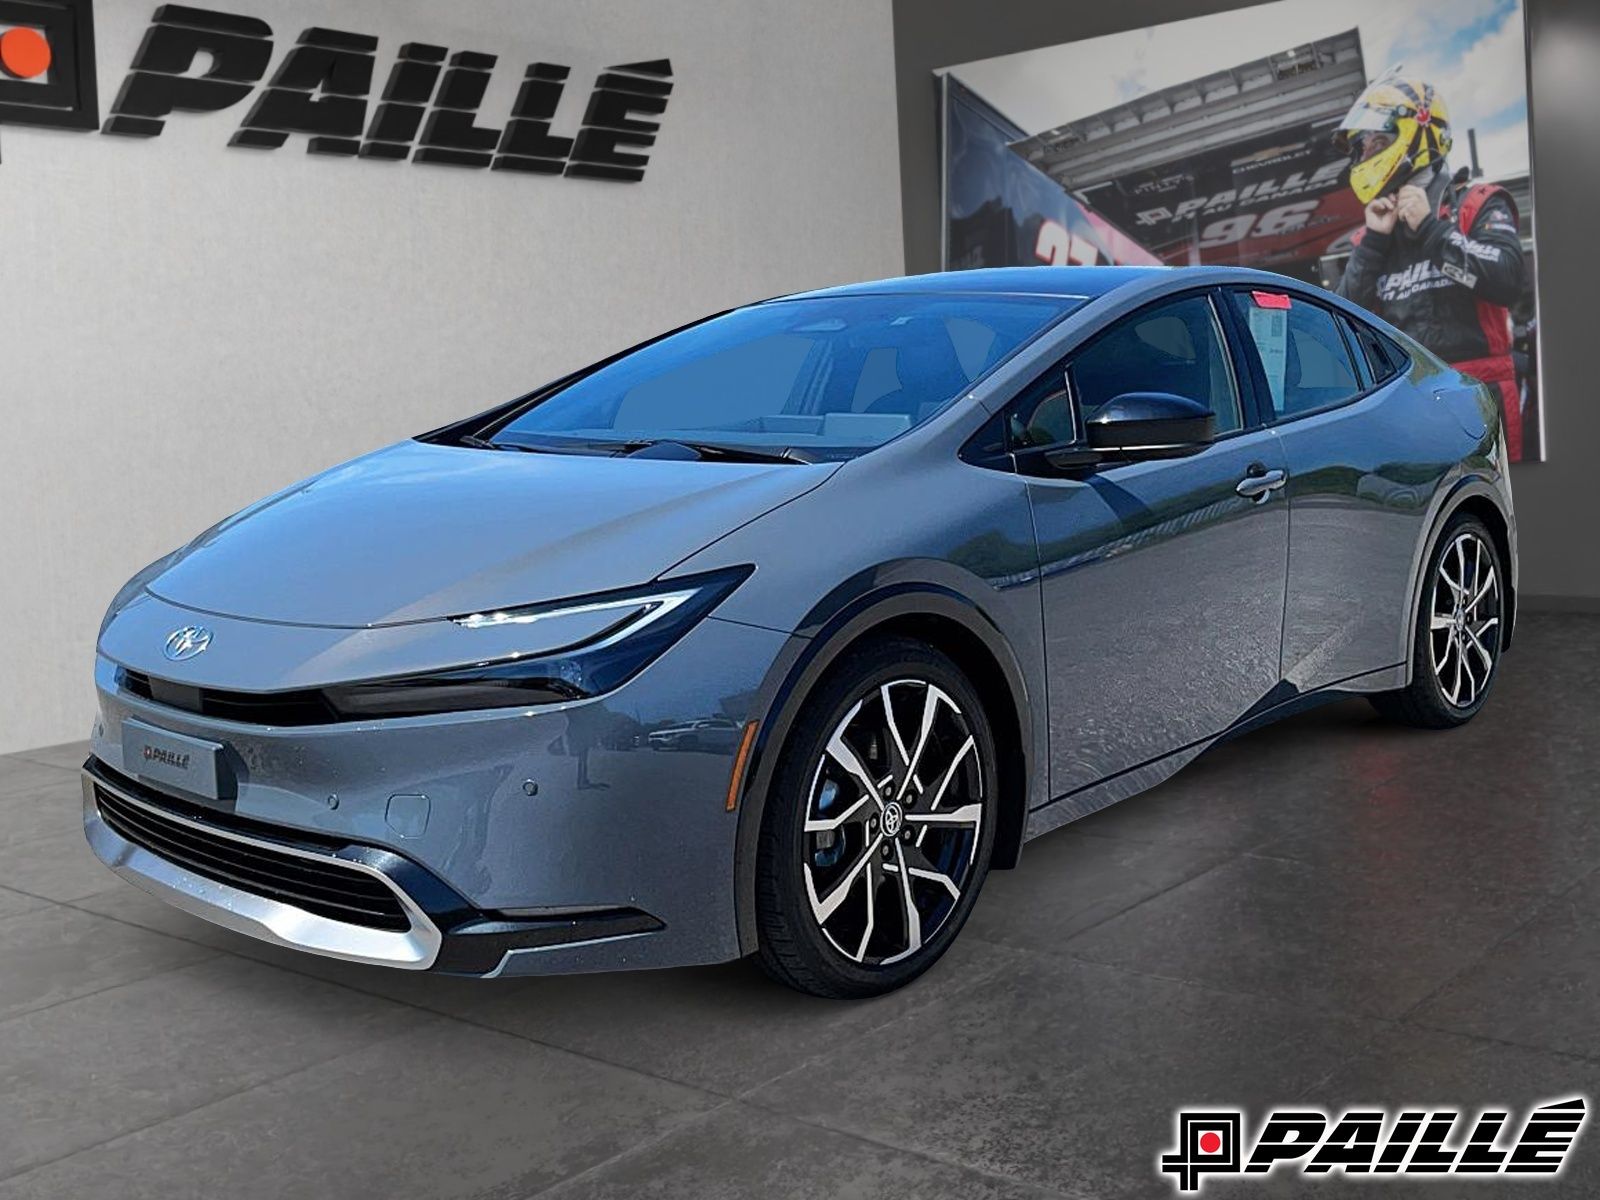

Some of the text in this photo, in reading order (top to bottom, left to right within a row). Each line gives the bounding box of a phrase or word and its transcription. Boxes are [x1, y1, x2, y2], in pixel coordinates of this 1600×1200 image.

[101, 4, 673, 182] PAILLÉ
[1238, 179, 1339, 208] CANADA
[1200, 200, 1320, 249] 96
